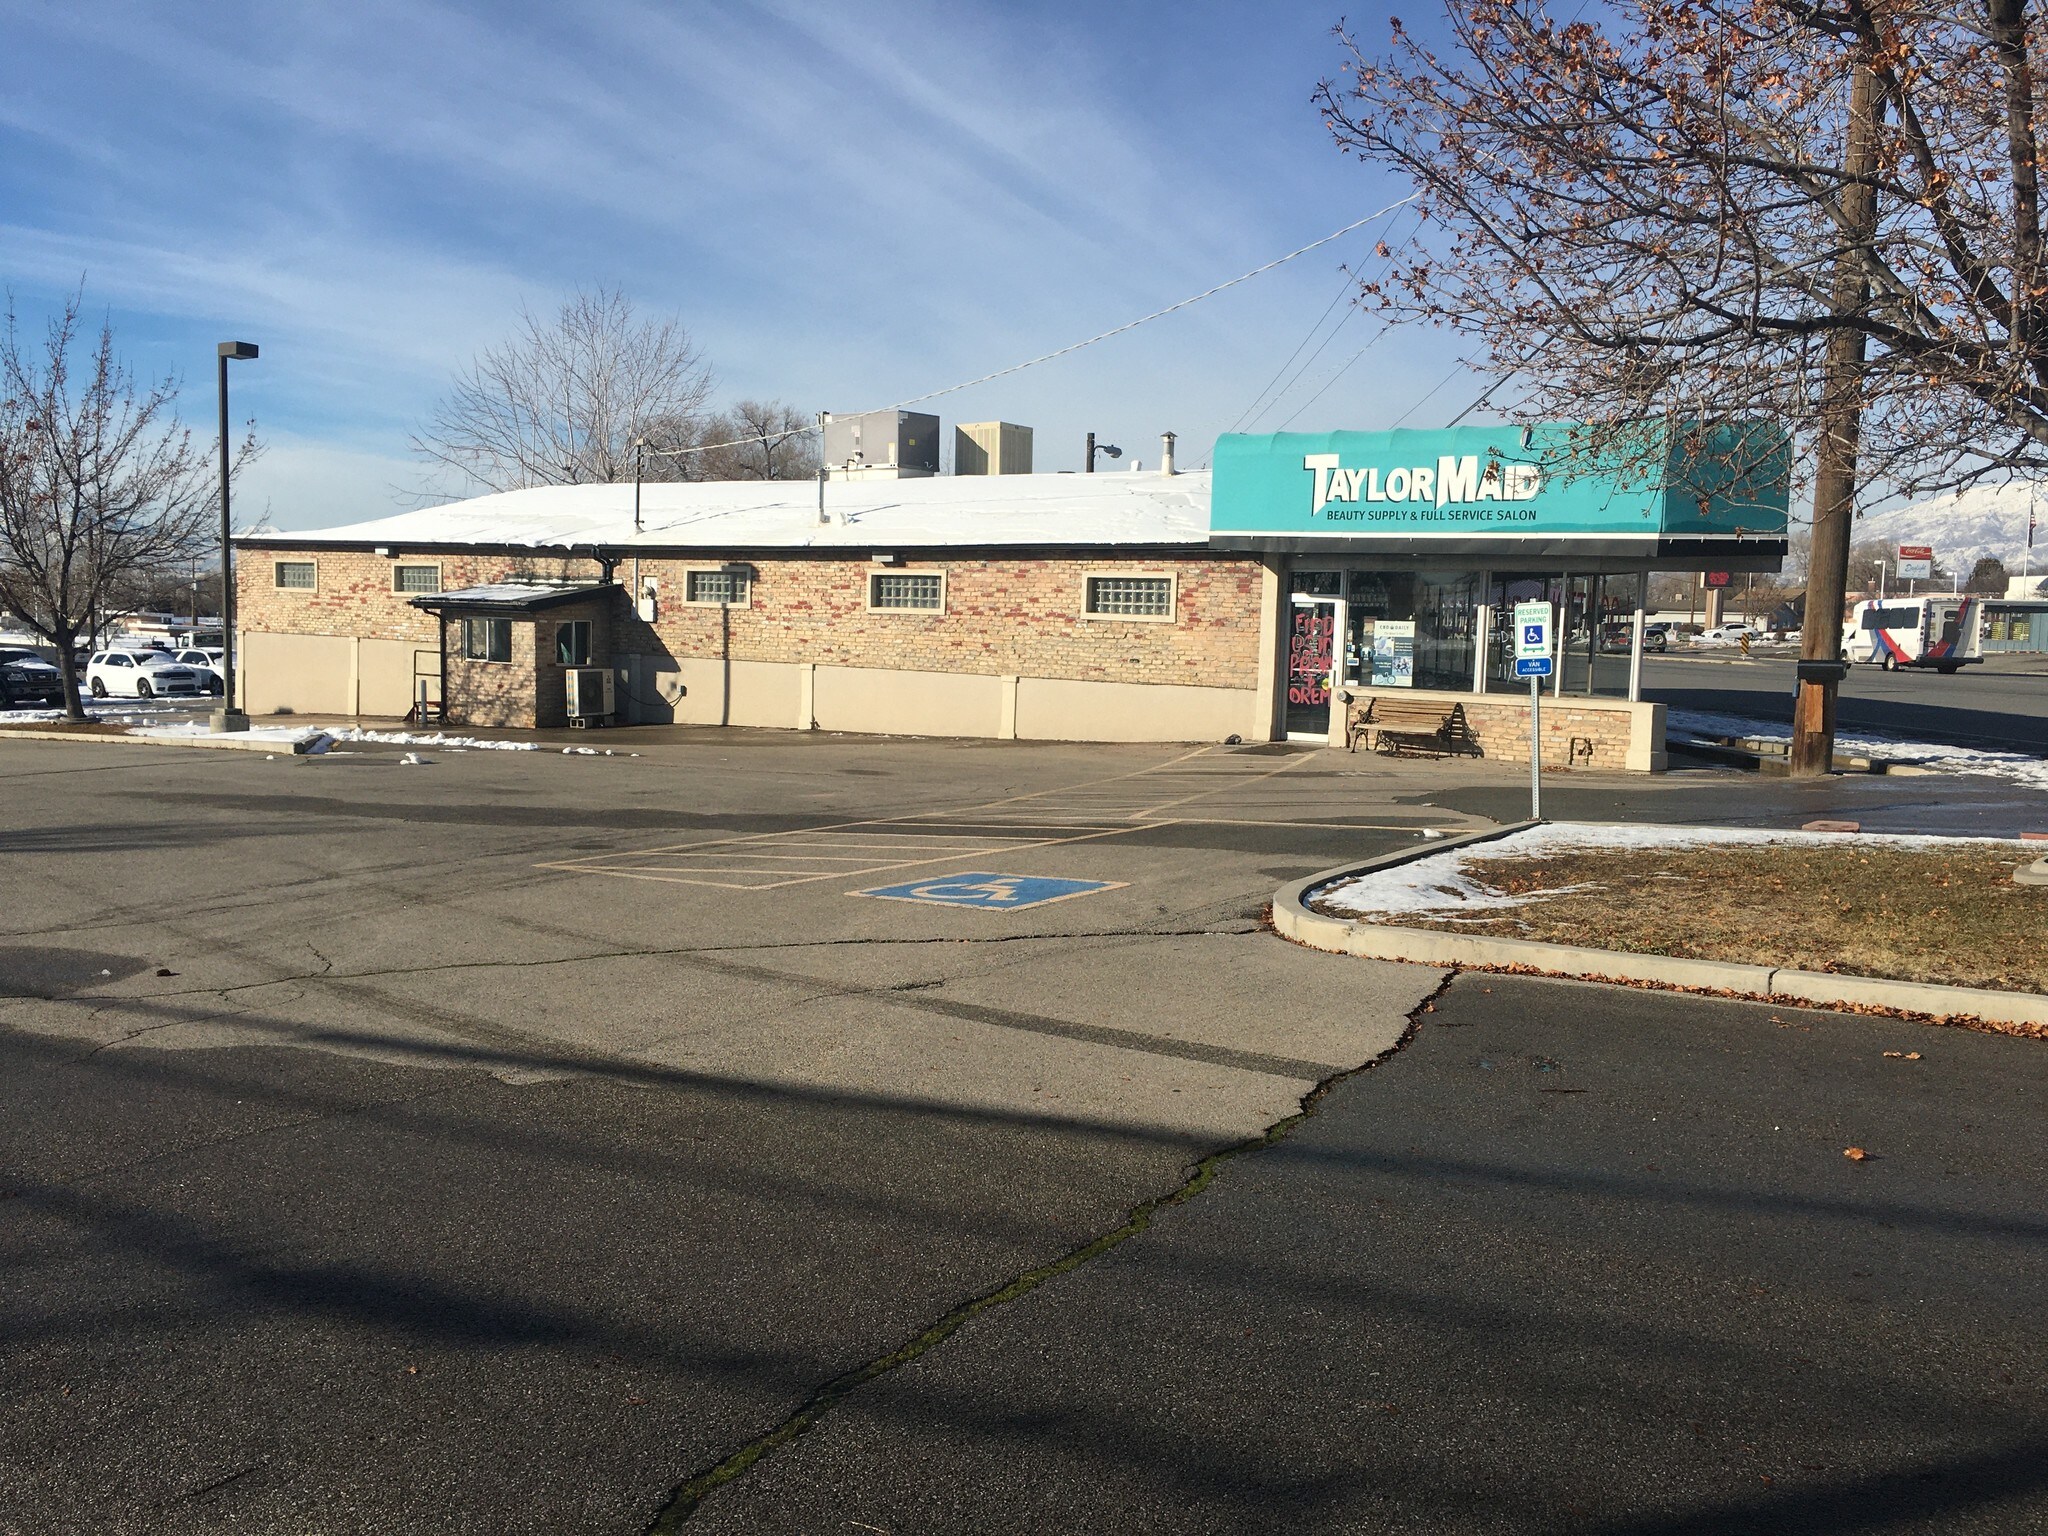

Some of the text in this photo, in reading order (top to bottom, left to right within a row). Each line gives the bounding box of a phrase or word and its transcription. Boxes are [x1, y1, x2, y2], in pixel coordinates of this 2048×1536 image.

[1327, 509, 1537, 521] BEAUTY SUPPLY & FULL SERVICE SALON
[1517, 608, 1549, 616] RESERVED
[1519, 616, 1547, 624] PARKING
[1289, 687, 1330, 706] OREM
